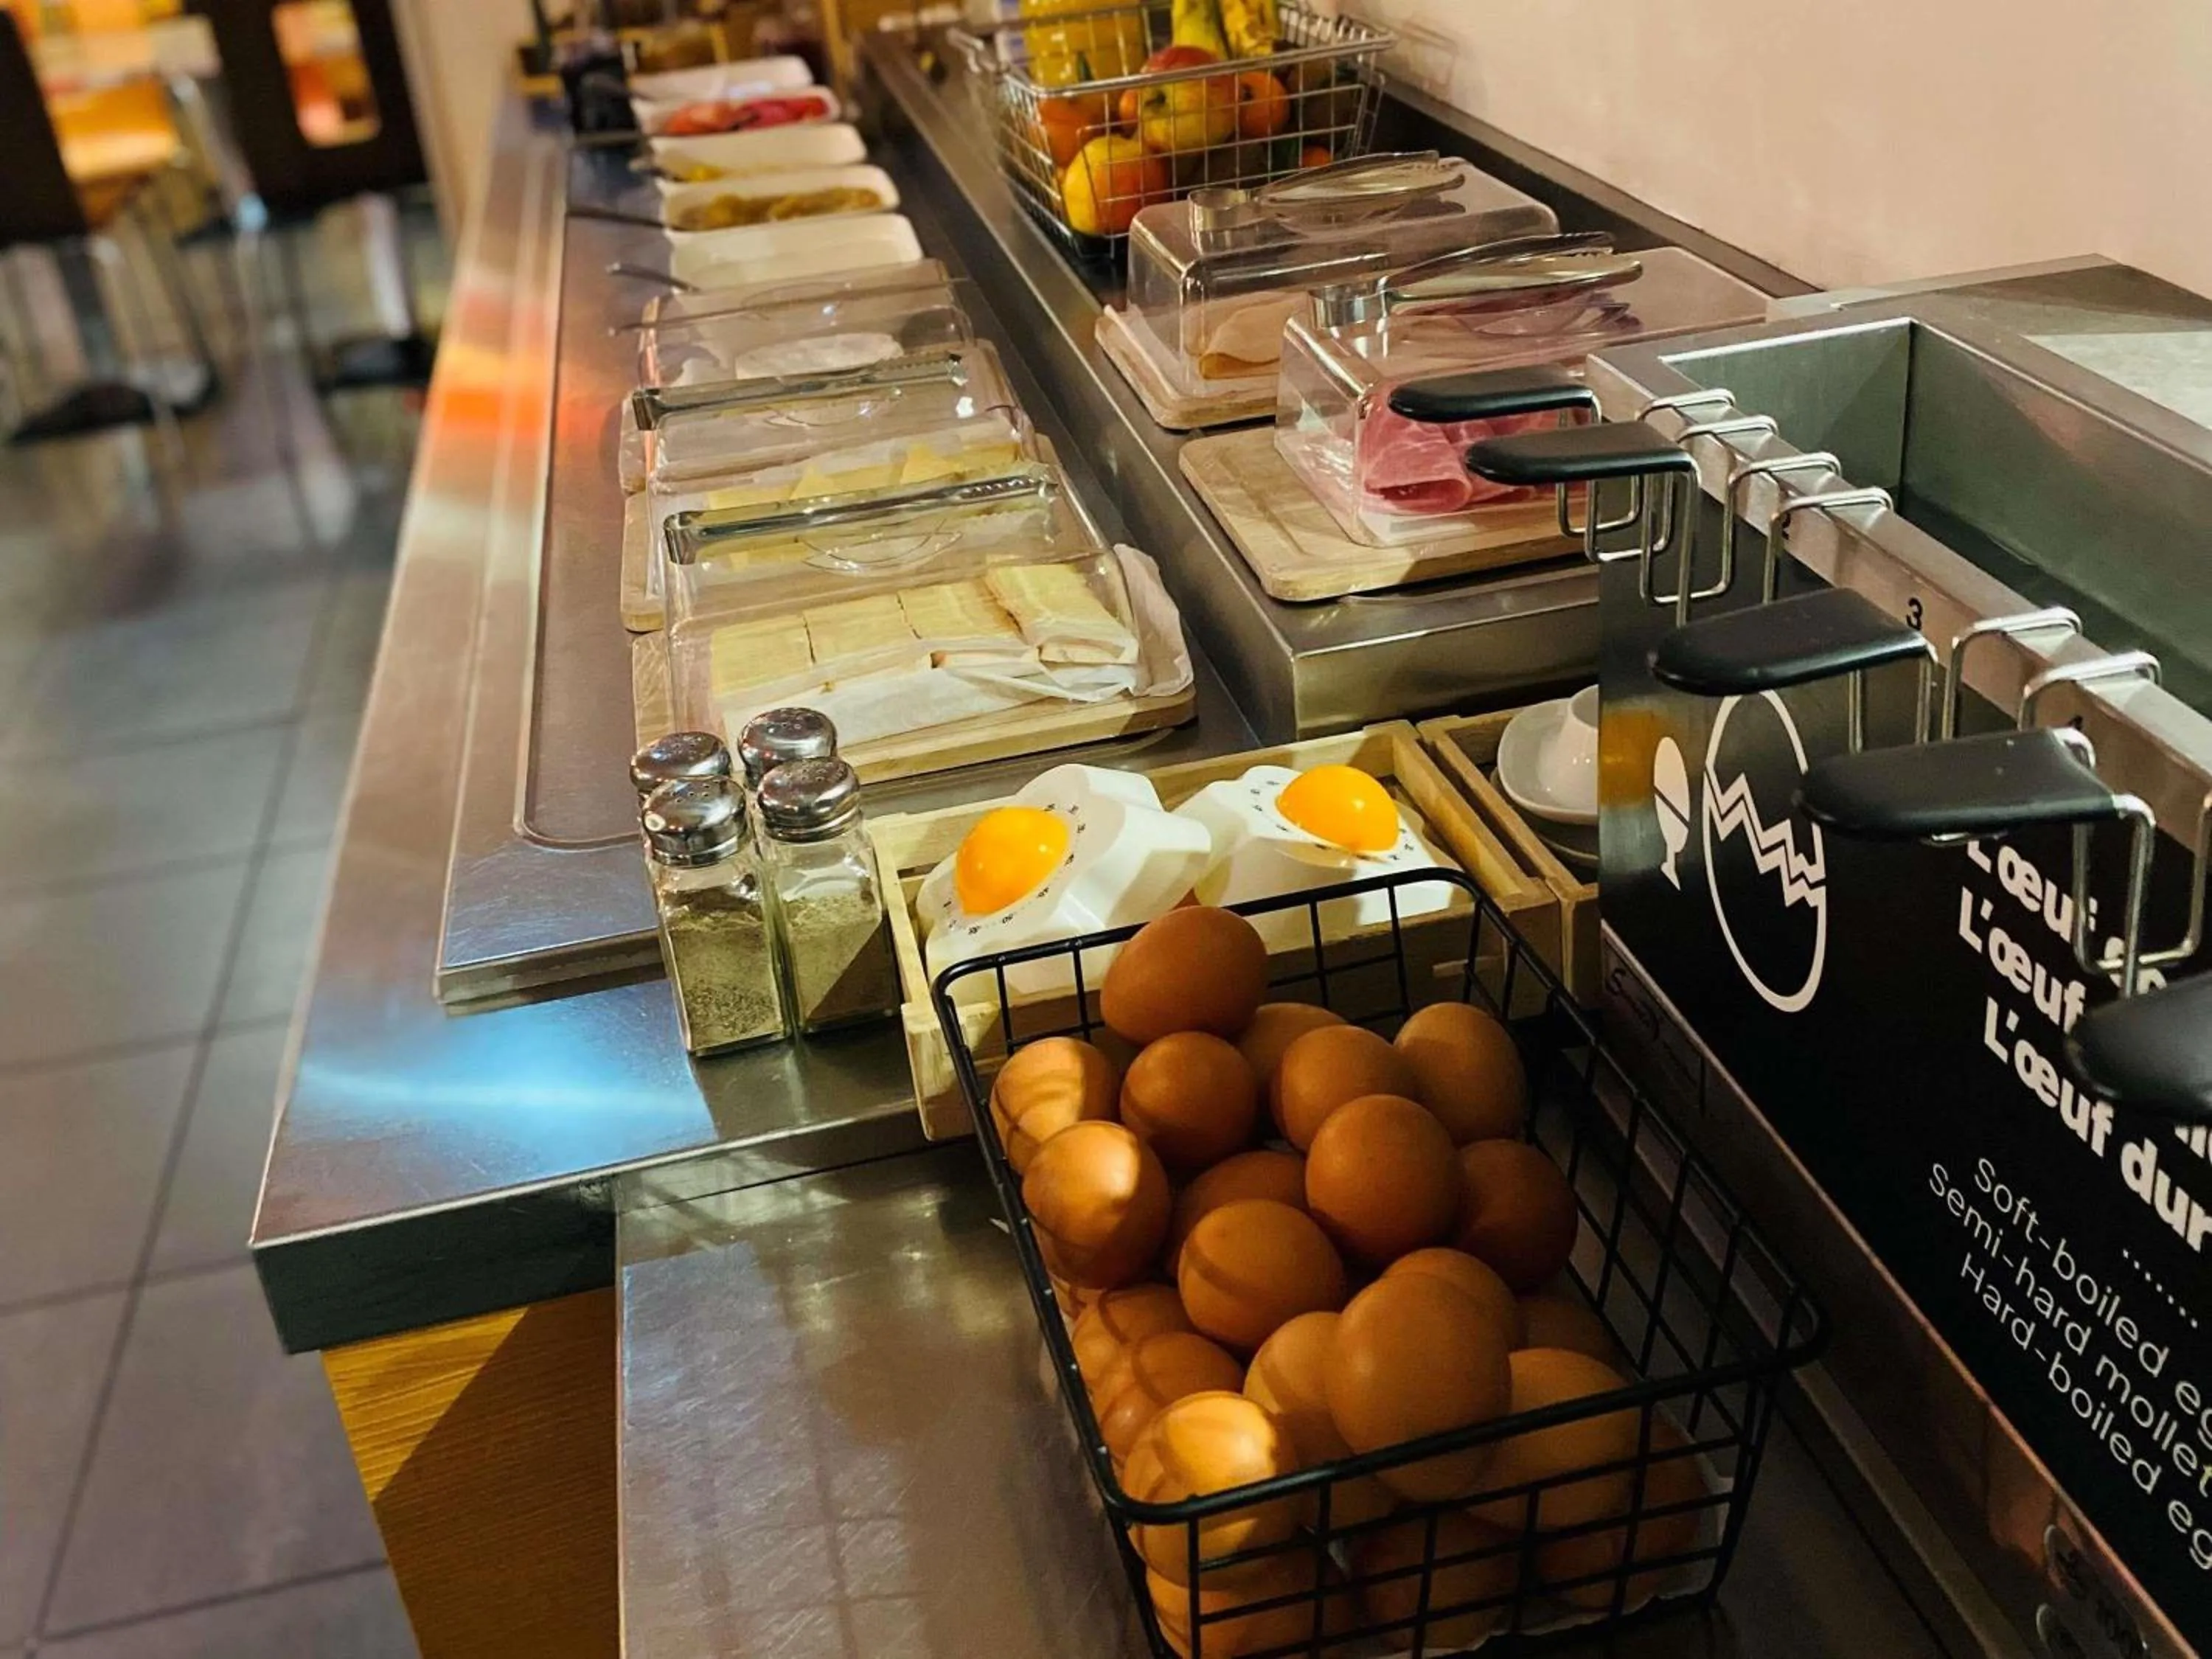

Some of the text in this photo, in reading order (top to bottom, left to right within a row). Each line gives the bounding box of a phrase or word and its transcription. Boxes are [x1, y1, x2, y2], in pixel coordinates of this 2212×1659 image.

[1906, 597, 1923, 631] 3
[1983, 996, 2212, 1253] L'œuf dur
[1928, 1163, 2092, 1356] Semi-hard
[1974, 1157, 2170, 1378] Soft-boiled
[1960, 1252, 2163, 1495] Hard-boiled
